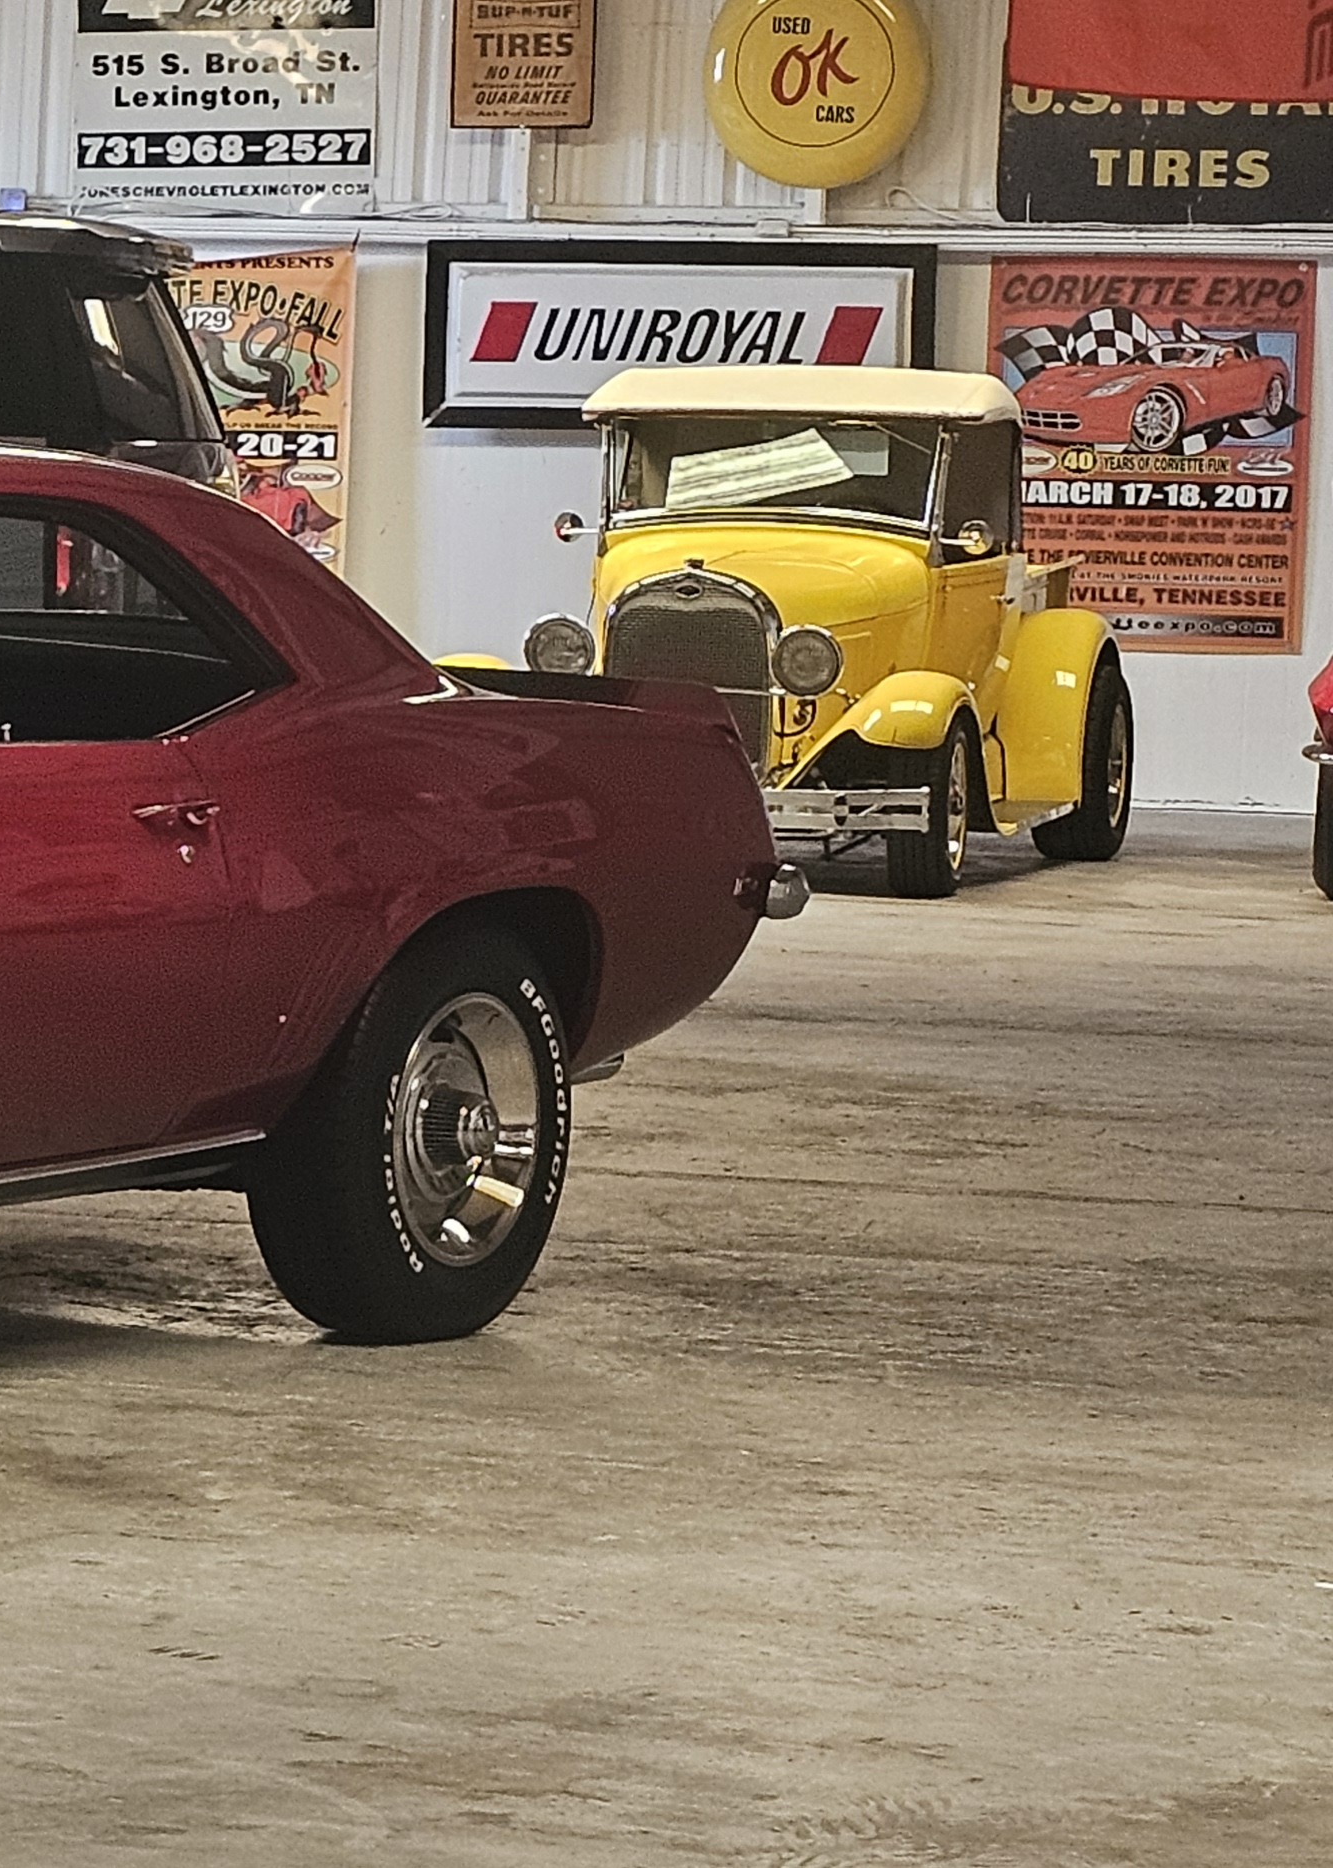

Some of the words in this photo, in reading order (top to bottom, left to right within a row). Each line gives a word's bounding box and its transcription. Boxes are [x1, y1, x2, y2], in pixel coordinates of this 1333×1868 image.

[772, 17, 811, 34] USED
[473, 33, 573, 58] TIRES
[92, 54, 144, 76] 515
[161, 53, 190, 75] S.
[205, 51, 300, 74] Broad
[317, 50, 361, 73] St.
[485, 65, 509, 80] NO
[514, 65, 563, 80] LIMIT
[771, 28, 860, 106] OK
[114, 85, 280, 111] Lexington,
[296, 83, 336, 105] TN
[815, 105, 855, 124] CARS
[81, 132, 368, 166] 731-968-2527
[1090, 149, 1271, 189] TIRES
[241, 256, 334, 270] PRESENTS
[171, 279, 203, 308] TE
[1002, 273, 1196, 306] CORVETTE
[1202, 277, 1305, 308] EXPO
[191, 311, 227, 329] 129
[534, 306, 807, 365] UNIROYAL
[237, 433, 336, 458] 20-21
[1063, 452, 1092, 470] 40
[1103, 457, 1135, 472] YEARS
[1138, 457, 1151, 472] OF
[1153, 457, 1205, 473] CORVETTE
[1120, 483, 1208, 509] 17-18,
[1214, 485, 1289, 509] 2017
[1039, 549, 1064, 565] THE
[1151, 551, 1234, 568] CONVENTION
[1237, 553, 1289, 570] CENTER
[1153, 588, 1286, 608] TENNESSEE
